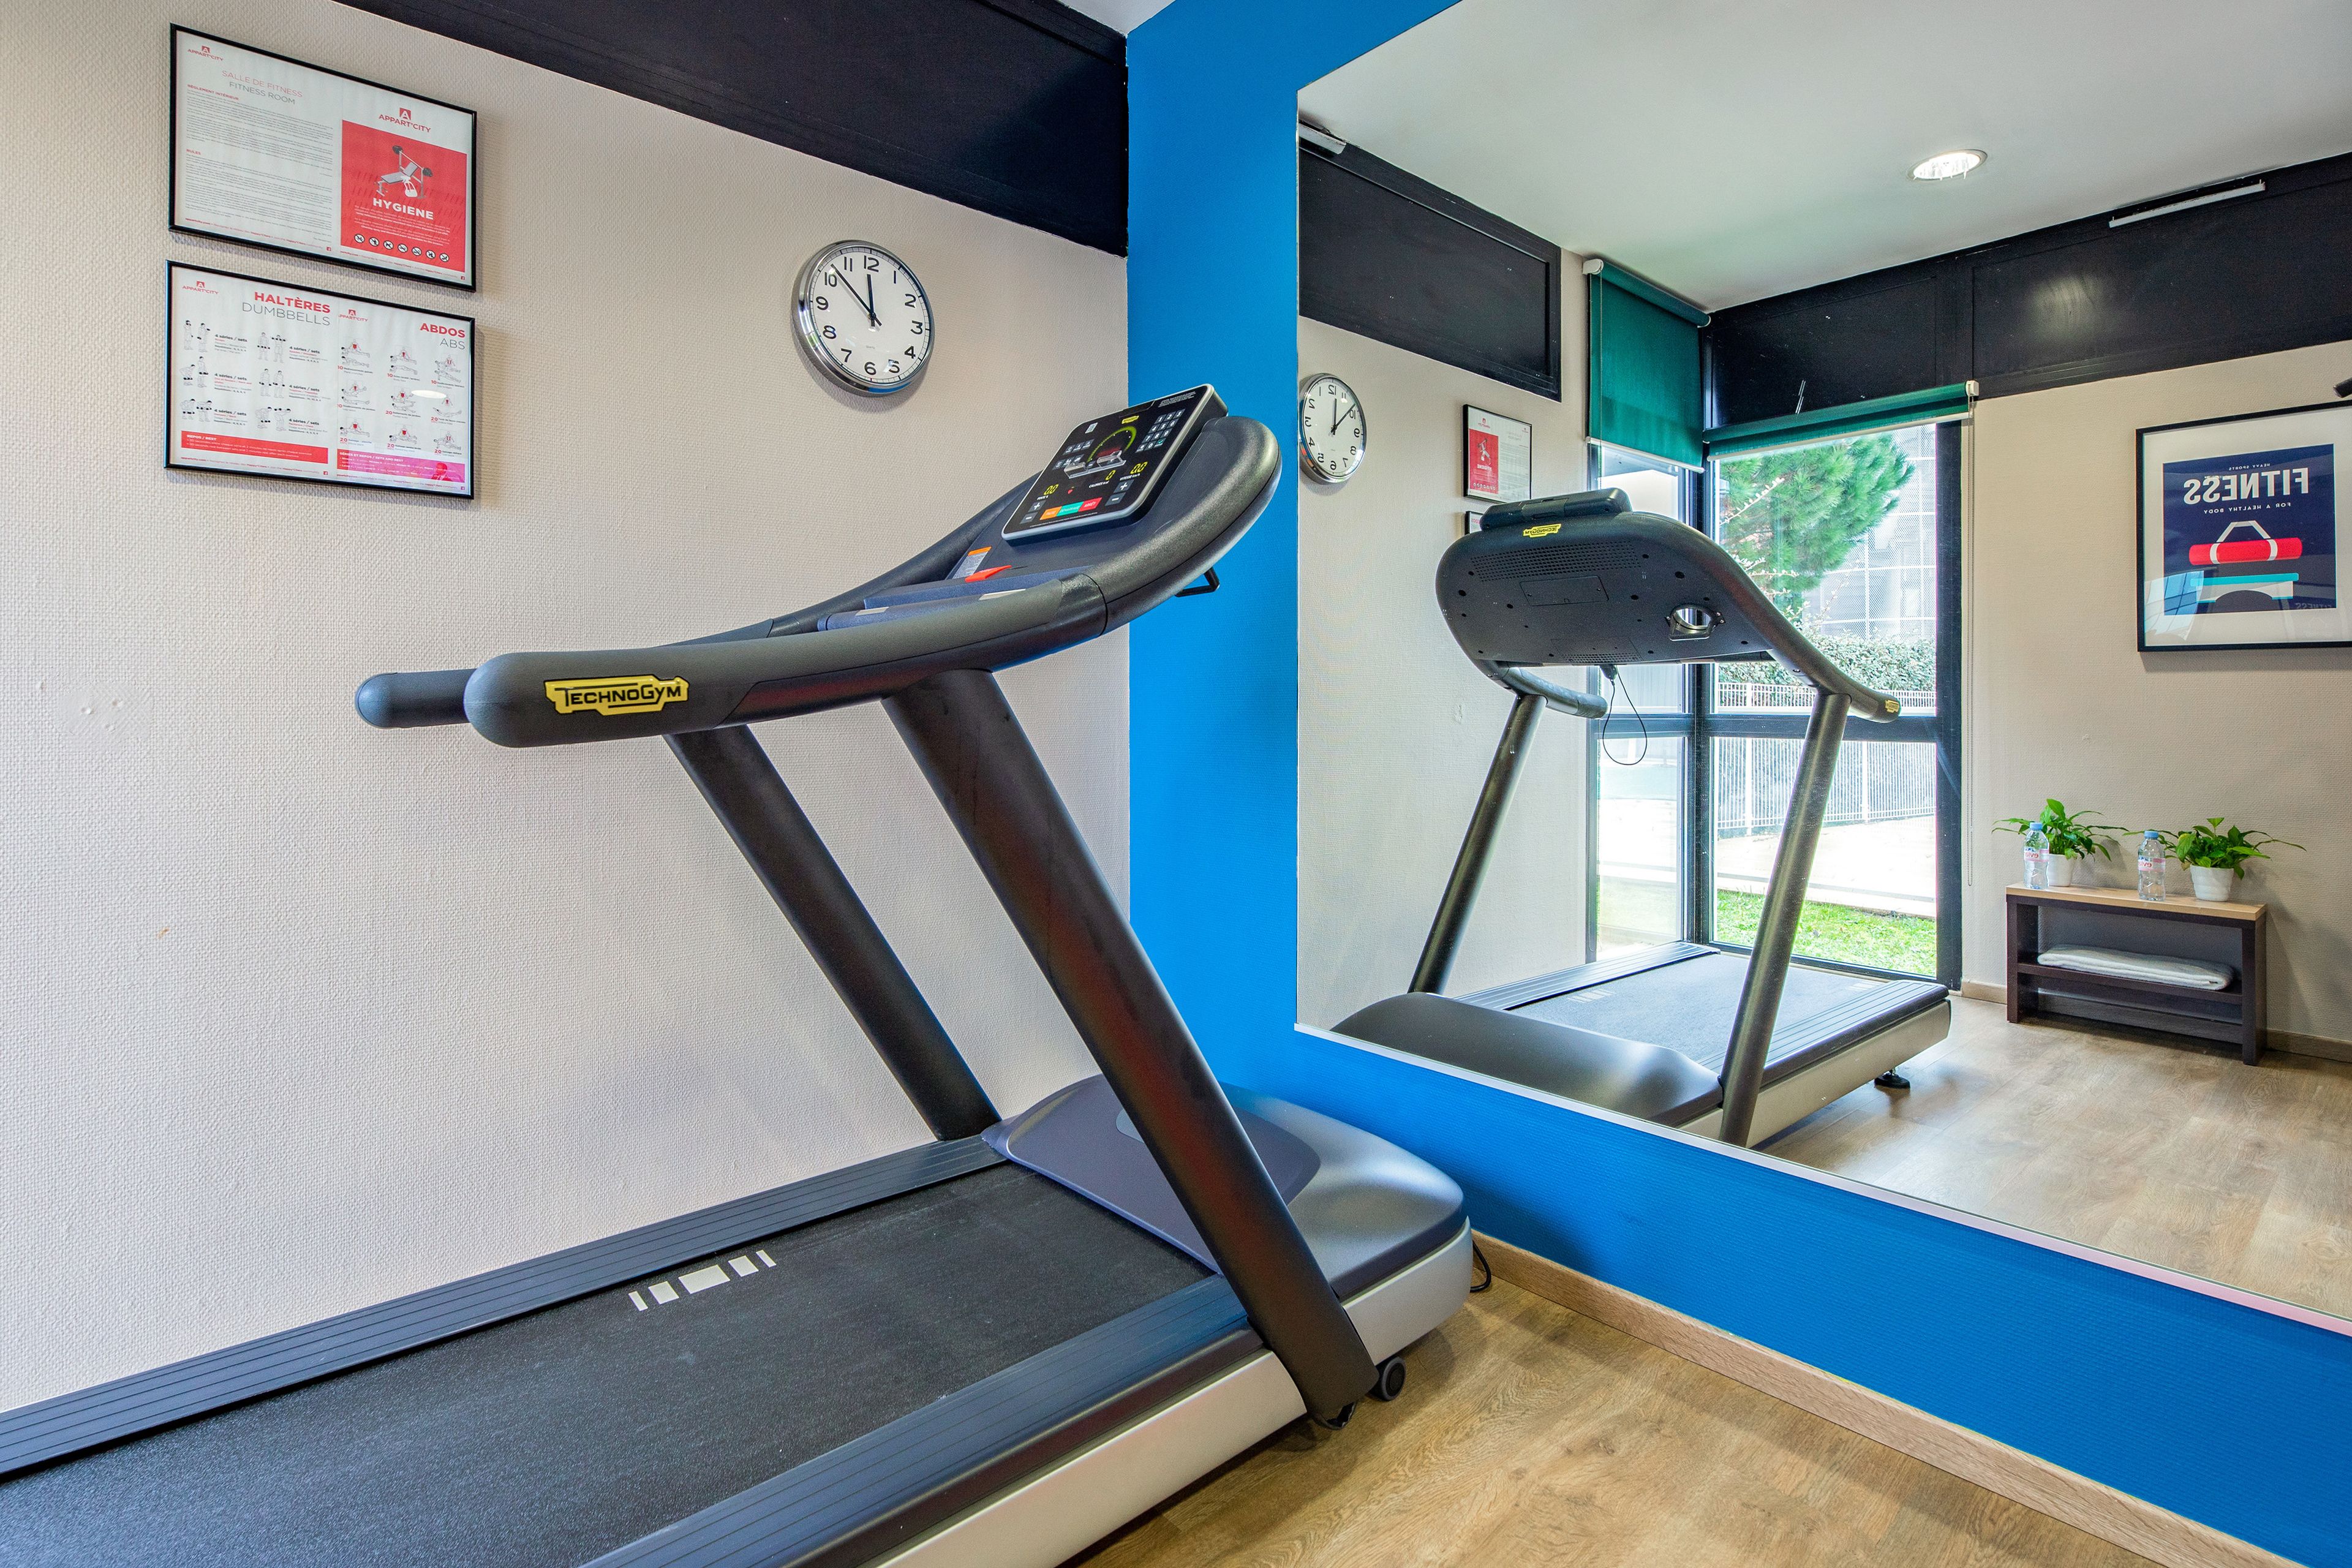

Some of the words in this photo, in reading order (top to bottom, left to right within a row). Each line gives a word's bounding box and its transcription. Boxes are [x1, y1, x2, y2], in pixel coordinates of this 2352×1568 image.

[187, 49, 224, 61] APPART'CITY
[222, 70, 251, 83] SALLE
[253, 78, 265, 88] DE
[267, 83, 303, 97] FITNESS
[229, 81, 266, 97] FITNESS
[268, 92, 295, 105] ROOM
[379, 114, 431, 132] APPART'CITY
[372, 197, 434, 220] HYGIENE
[844, 256, 853, 272] 11
[864, 255, 880, 273] 12
[824, 271, 837, 287] 10
[894, 270, 897, 284] 1
[183, 285, 219, 295] APPART'CITY
[254, 292, 331, 314] HALTÈRES
[815, 296, 829, 311] 9
[905, 293, 916, 308] 2
[243, 302, 331, 326] DUMBBELLS
[420, 323, 466, 338] ABDOS
[823, 325, 837, 339] 8
[910, 320, 923, 334] 3
[440, 338, 466, 350] ABS
[841, 348, 852, 363] 7
[904, 345, 916, 359] 4
[864, 361, 876, 375] 6
[888, 359, 900, 374] 5
[1105, 470, 1116, 481] 0
[554, 682, 681, 709] TECHNOGYM
